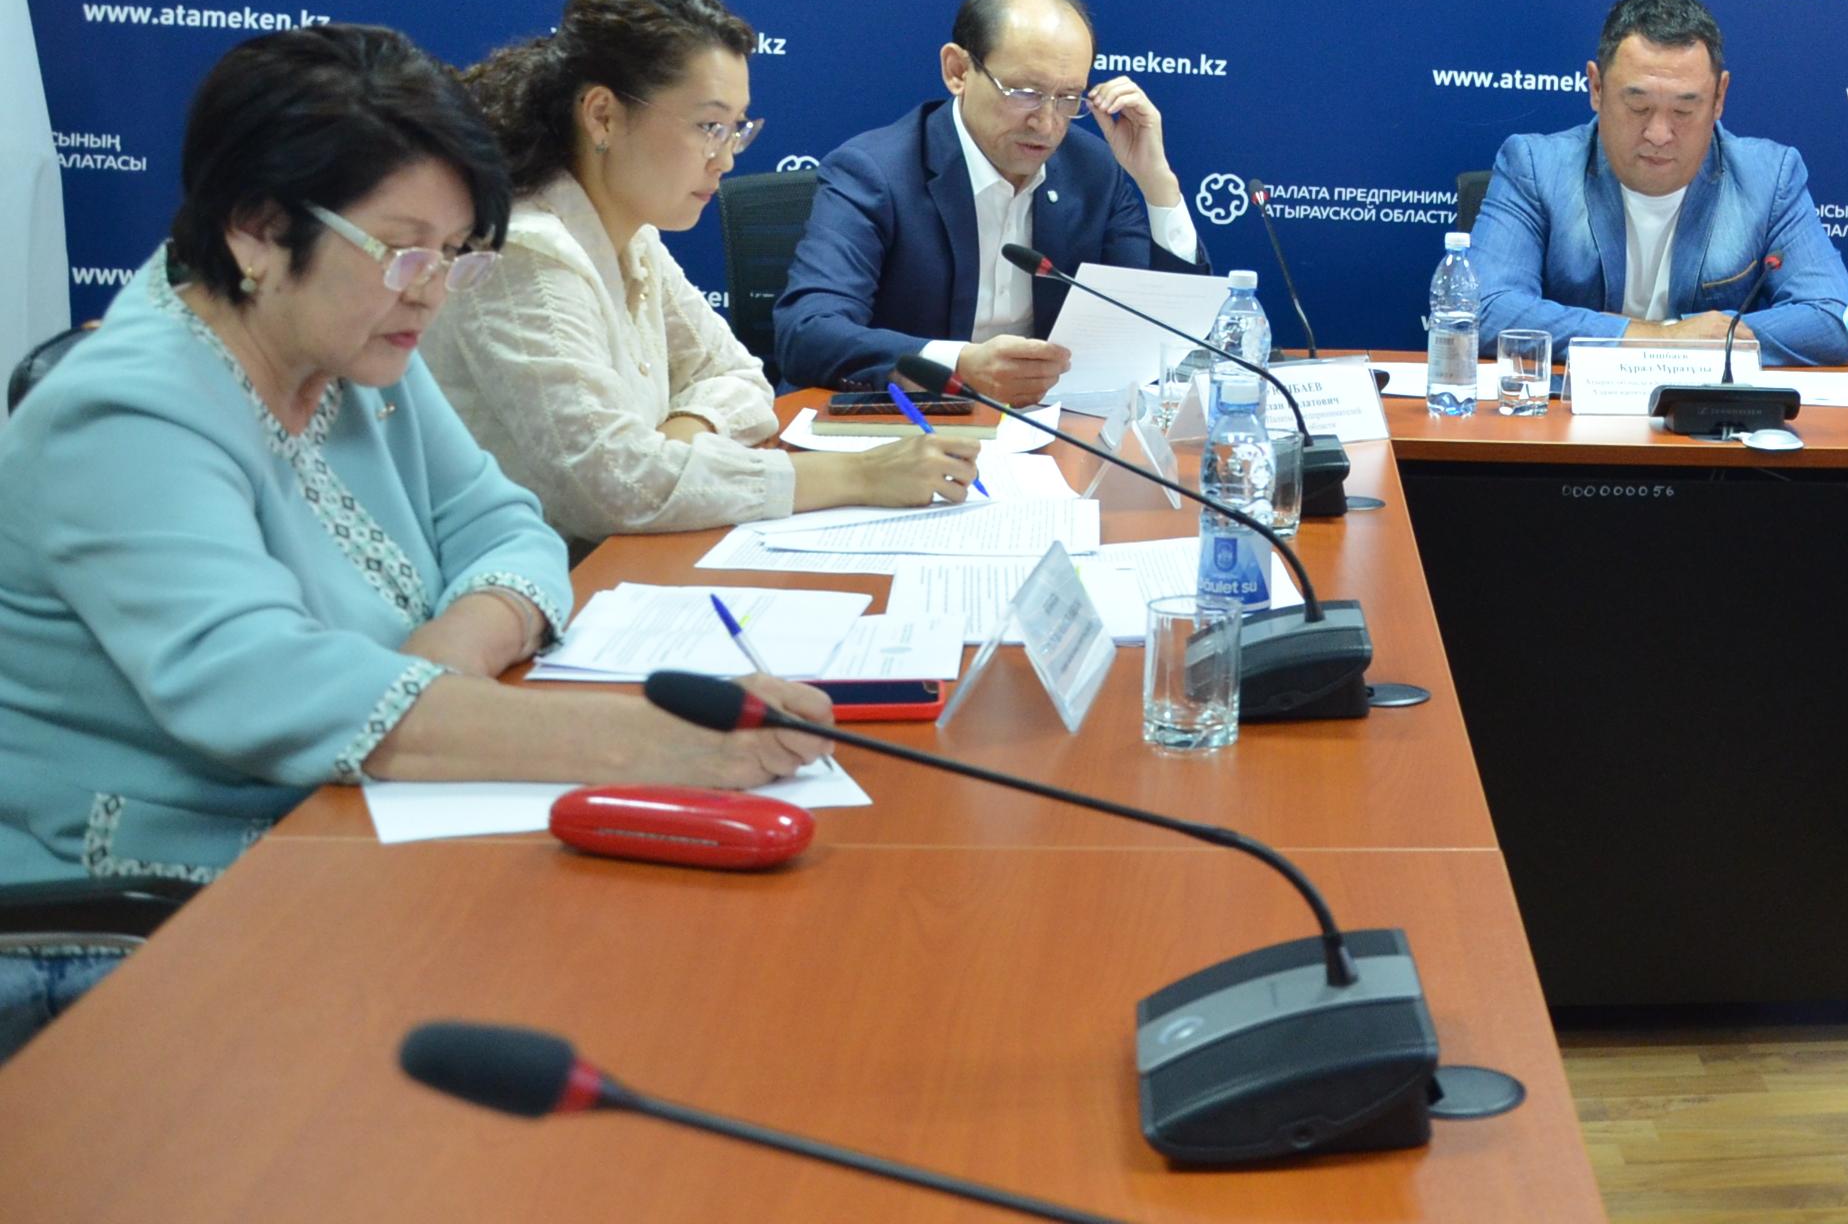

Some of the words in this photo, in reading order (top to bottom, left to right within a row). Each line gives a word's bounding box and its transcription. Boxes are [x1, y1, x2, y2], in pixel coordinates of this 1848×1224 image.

[83, 3, 330, 32] www.atameken.kz
[1093, 51, 1227, 76] ameken.kz
[1432, 69, 1589, 93] www.atamek
[50, 131, 121, 152] СЫНЫҢ
[57, 153, 147, 171] АЛАТАСЫ
[1264, 184, 1330, 200] ПАЛАТА
[1334, 187, 1458, 205] ПРЕДПРИНИМ
[1262, 203, 1376, 222] АТЫРАУСКОЙ
